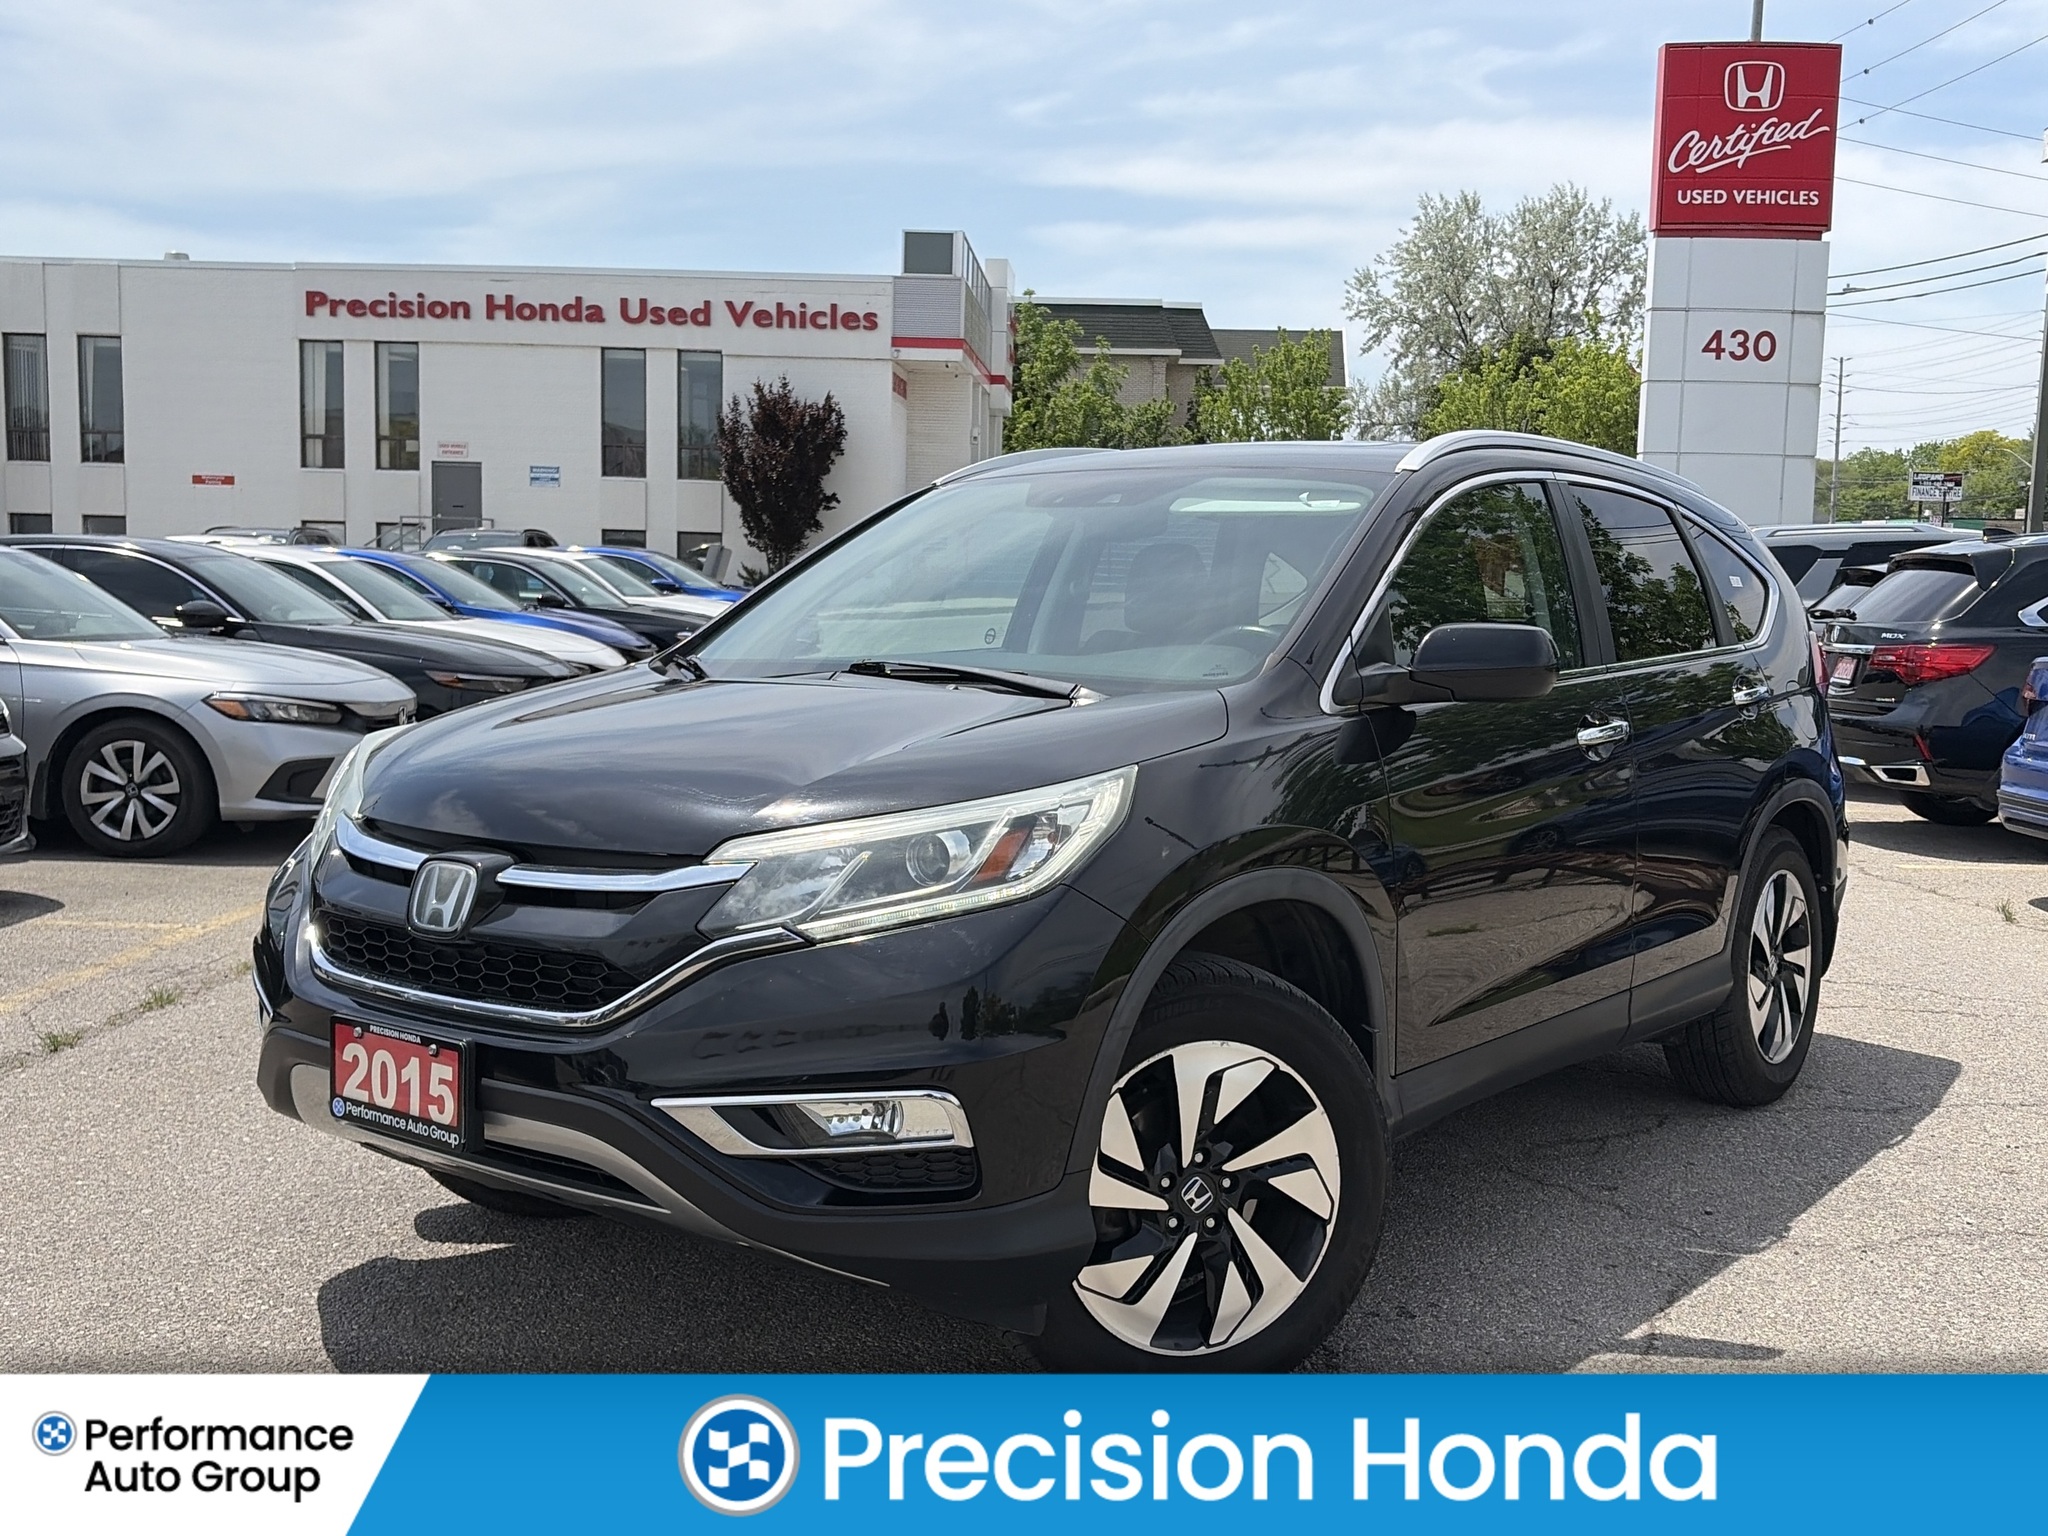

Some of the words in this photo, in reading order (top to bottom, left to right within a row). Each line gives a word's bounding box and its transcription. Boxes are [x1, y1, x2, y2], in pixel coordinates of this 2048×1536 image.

[1668, 108, 1831, 173] Certified
[1677, 189, 1727, 205] USED
[1733, 189, 1820, 206] VEHICLES
[305, 290, 471, 320] Precision
[485, 293, 606, 323] Honda
[619, 297, 712, 327] Used
[724, 300, 879, 331] Vehicles
[1701, 329, 1777, 363] 430
[1911, 486, 1938, 498] FINANCE
[1881, 632, 1907, 640] MDX
[369, 1024, 400, 1040] PRECISION
[399, 1031, 422, 1045] HONDA
[342, 1042, 455, 1126] 2015
[346, 1101, 407, 1130] Performance
[406, 1117, 429, 1137] Auto
[429, 1125, 460, 1149] Group
